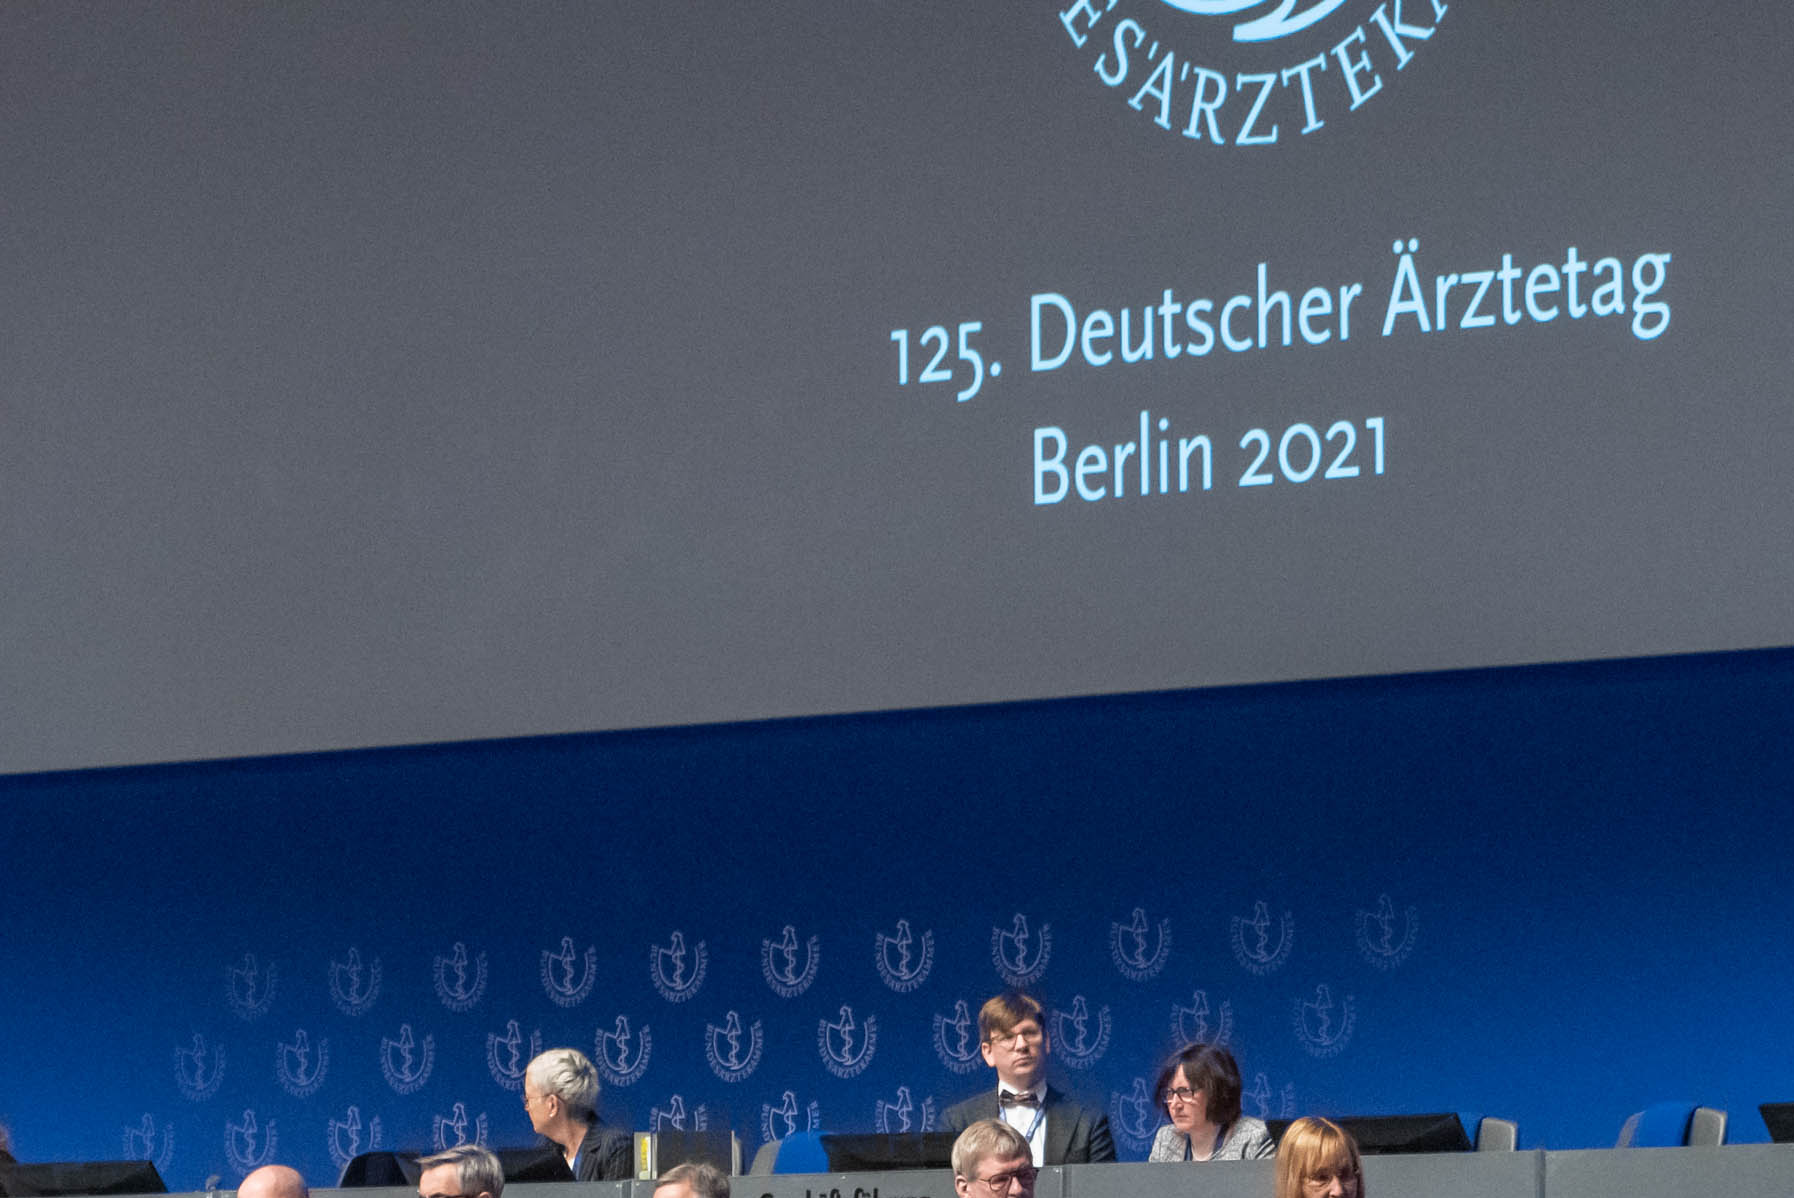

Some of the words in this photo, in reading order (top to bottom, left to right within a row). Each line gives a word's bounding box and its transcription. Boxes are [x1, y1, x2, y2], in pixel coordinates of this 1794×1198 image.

[890, 321, 1001, 402] 125.
[1030, 262, 1363, 371] Deutscher
[1382, 238, 1672, 340] Ärztetag
[1034, 410, 1212, 505] Berlin
[1239, 416, 1384, 487] 2021
